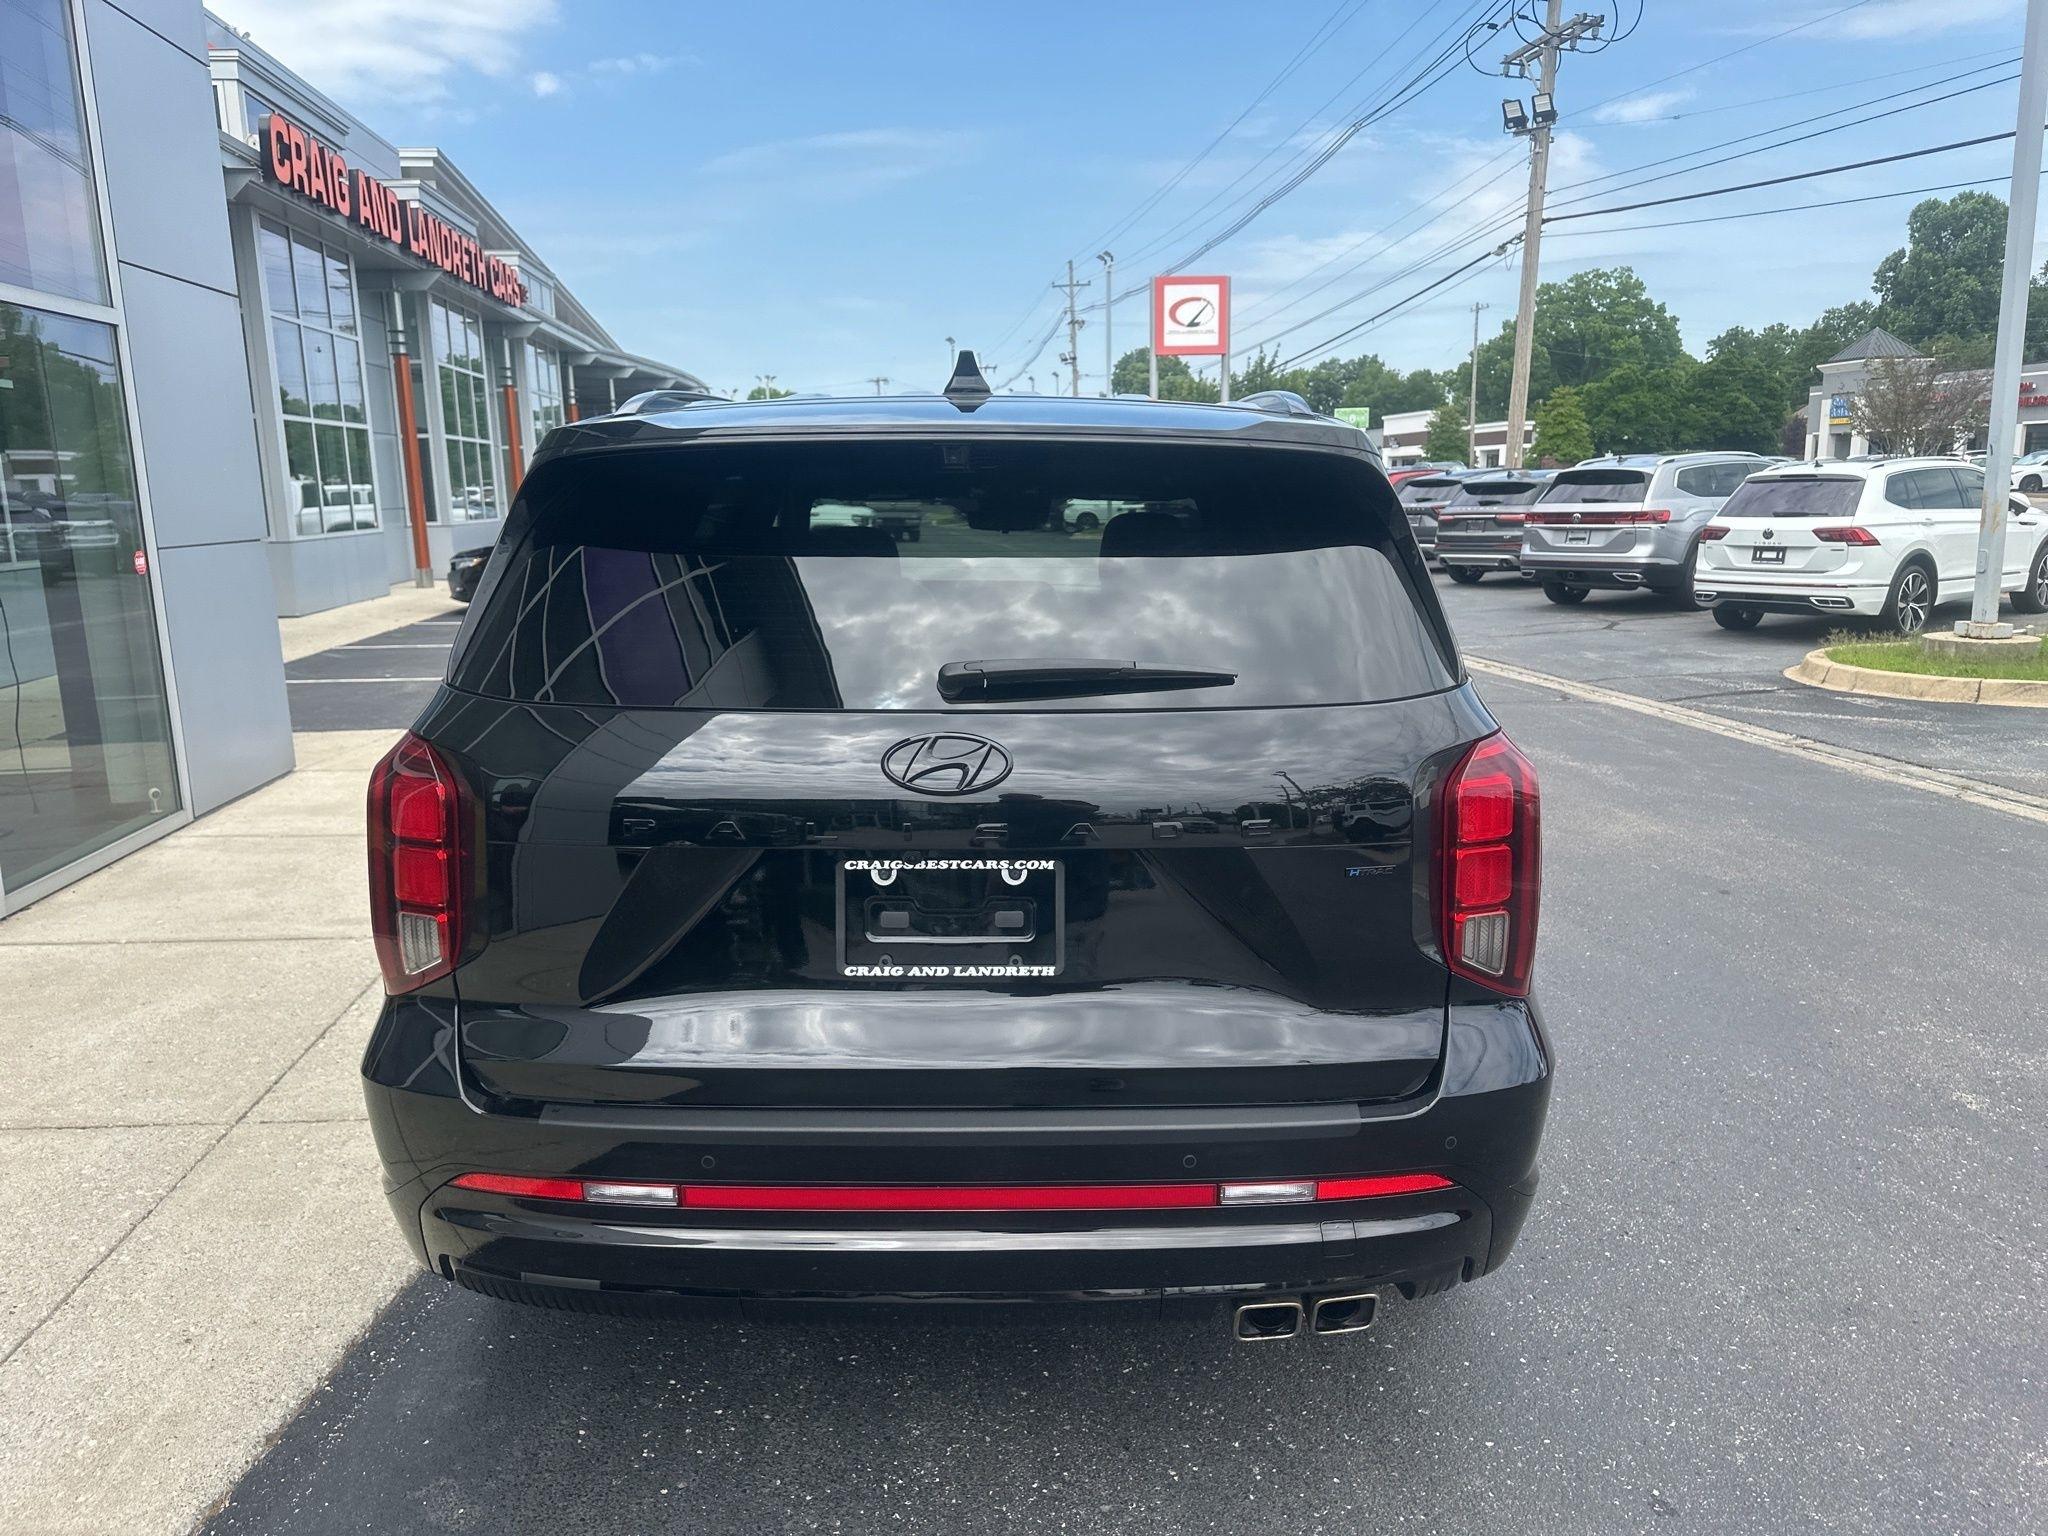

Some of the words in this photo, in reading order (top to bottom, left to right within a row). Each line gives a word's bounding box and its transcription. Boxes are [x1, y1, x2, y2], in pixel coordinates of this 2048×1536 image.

[268, 113, 350, 217] CRAIG
[357, 168, 402, 244] AND
[406, 200, 488, 292] LANDRETH
[489, 254, 521, 308] CARS
[623, 818, 1272, 841] PALISADE
[844, 859, 1056, 871] CRAIGSBESTCARS.COM
[844, 966, 904, 977] CRAIG
[907, 966, 949, 977] AND
[953, 966, 1056, 977] LANDRETH
